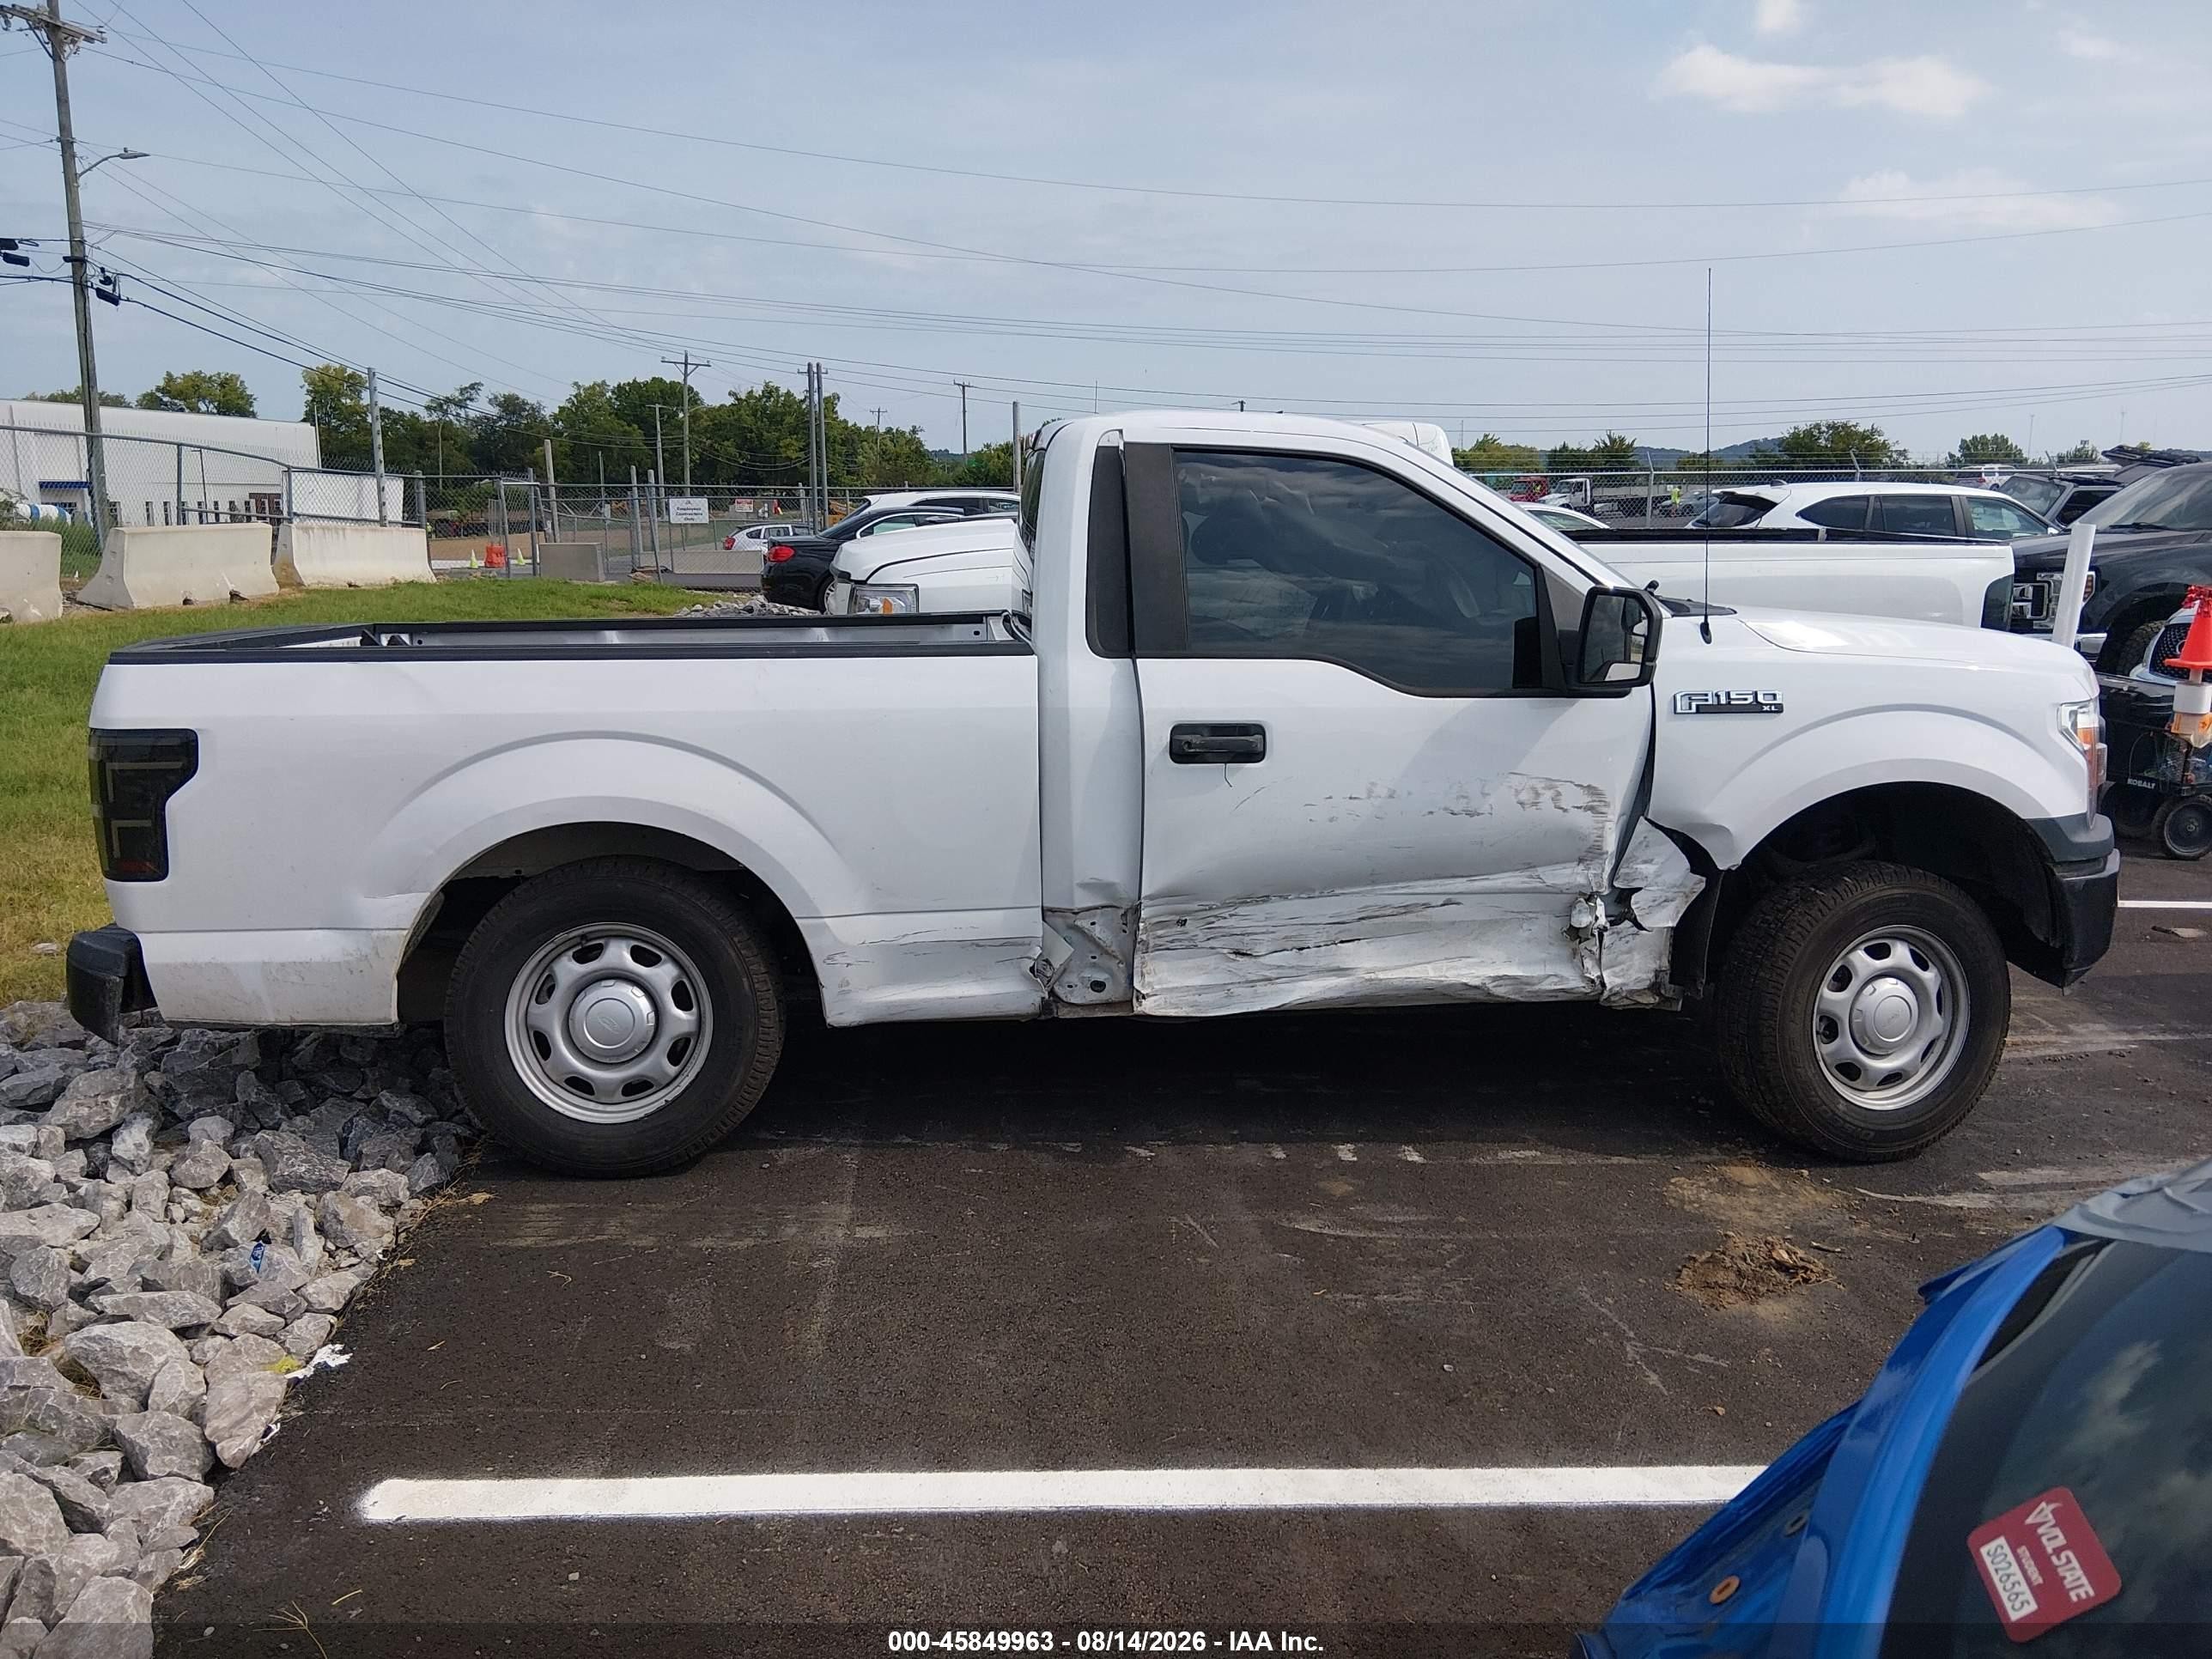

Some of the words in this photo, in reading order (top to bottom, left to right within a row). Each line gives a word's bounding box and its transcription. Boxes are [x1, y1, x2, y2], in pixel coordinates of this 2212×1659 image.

[2037, 1516, 2068, 1555] VOL
[1987, 1544, 2030, 1612] S026565
[2017, 1545, 2044, 1586] STUDENT
[2051, 1549, 2095, 1603] STATE
